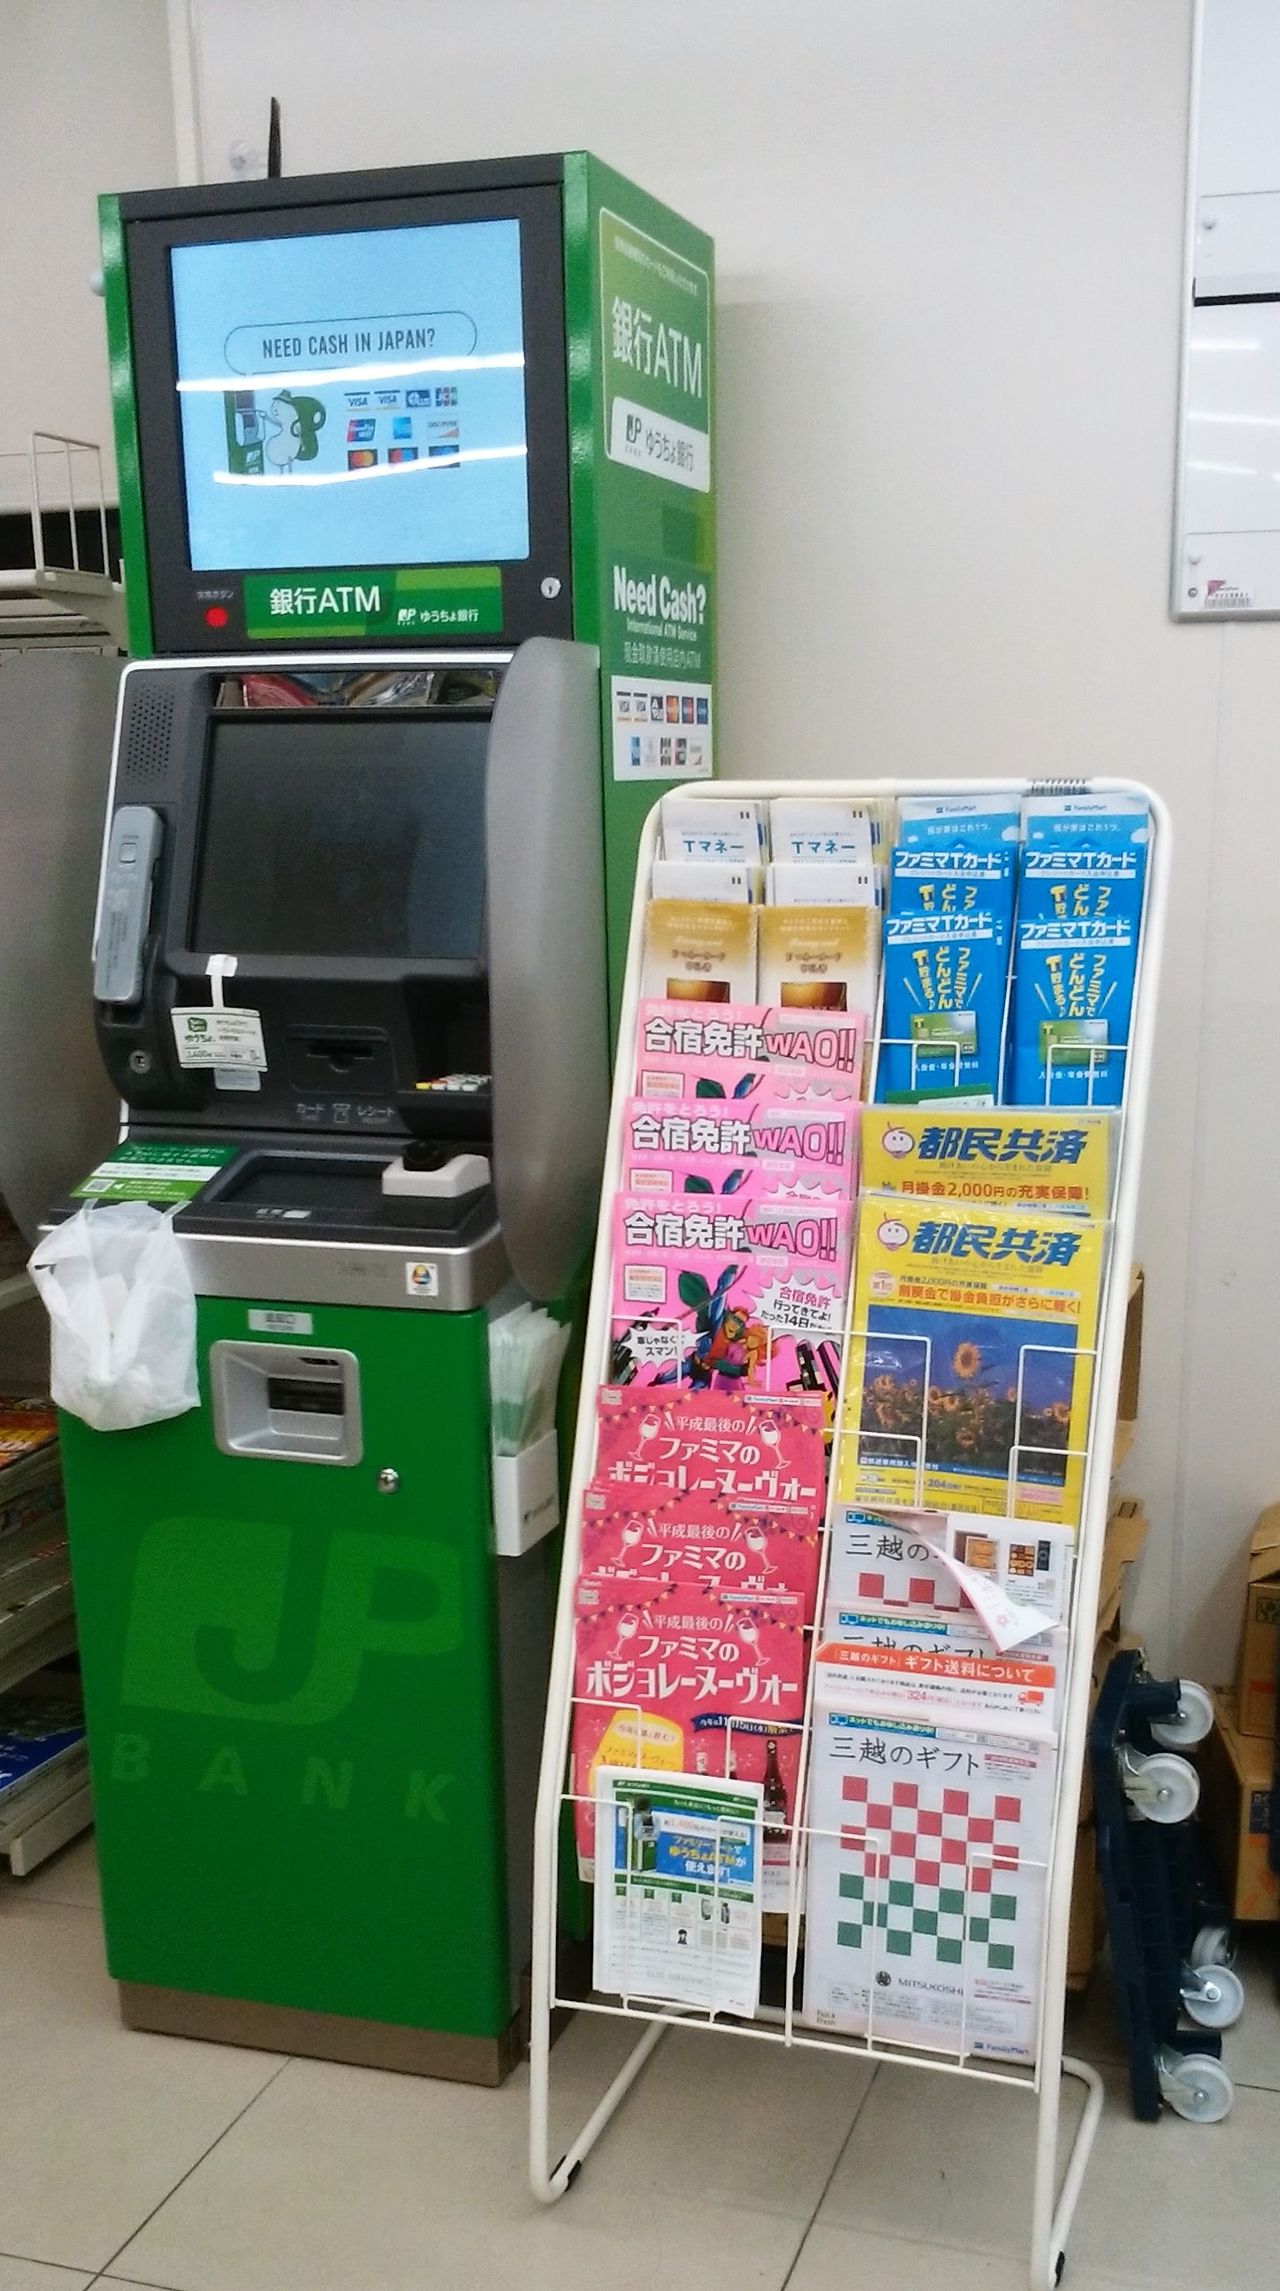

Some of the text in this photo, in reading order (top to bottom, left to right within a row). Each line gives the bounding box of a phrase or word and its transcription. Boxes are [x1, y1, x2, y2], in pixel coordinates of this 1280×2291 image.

[262, 328, 436, 359] NEED CASH IN JAPAN?
[612, 296, 702, 398] 銀行ATM
[645, 429, 694, 472] ゆうちょ銀行
[270, 586, 381, 616] 銀行ATM
[612, 565, 707, 625] Need Cash?
[420, 609, 480, 624] ゆうちょ銀行
[683, 840, 744, 854] Tマネー
[792, 840, 856, 854] Tマネー
[1025, 850, 1136, 869] ファミマTカード
[895, 851, 1002, 869] ファミマTカード
[886, 913, 993, 934] ファミマTカード
[1020, 919, 1131, 940] ファミマTカード
[918, 1126, 1089, 1165] 都民共済
[912, 1221, 1084, 1267] 都民共済
[773, 1299, 832, 1322] 行ってきてよ!
[779, 1286, 831, 1310] 合宿免許
[675, 1416, 746, 1433] 平成最後の
[659, 1437, 761, 1465] ファミマの
[659, 1523, 730, 1540] 平成最後の
[641, 1544, 746, 1570] ファミマの
[846, 1534, 934, 1562] 三越の
[654, 1615, 723, 1631] 平成最後の
[638, 1635, 740, 1662] ファミマの
[905, 1657, 1035, 1682] ギフト送料について
[585, 1661, 798, 1705] ボジョレーヌーヴォー
[829, 1737, 980, 1776] 三越のギフト
[110, 1733, 455, 1824] BANK
[897, 1977, 964, 1997] MITSUKOSHI
